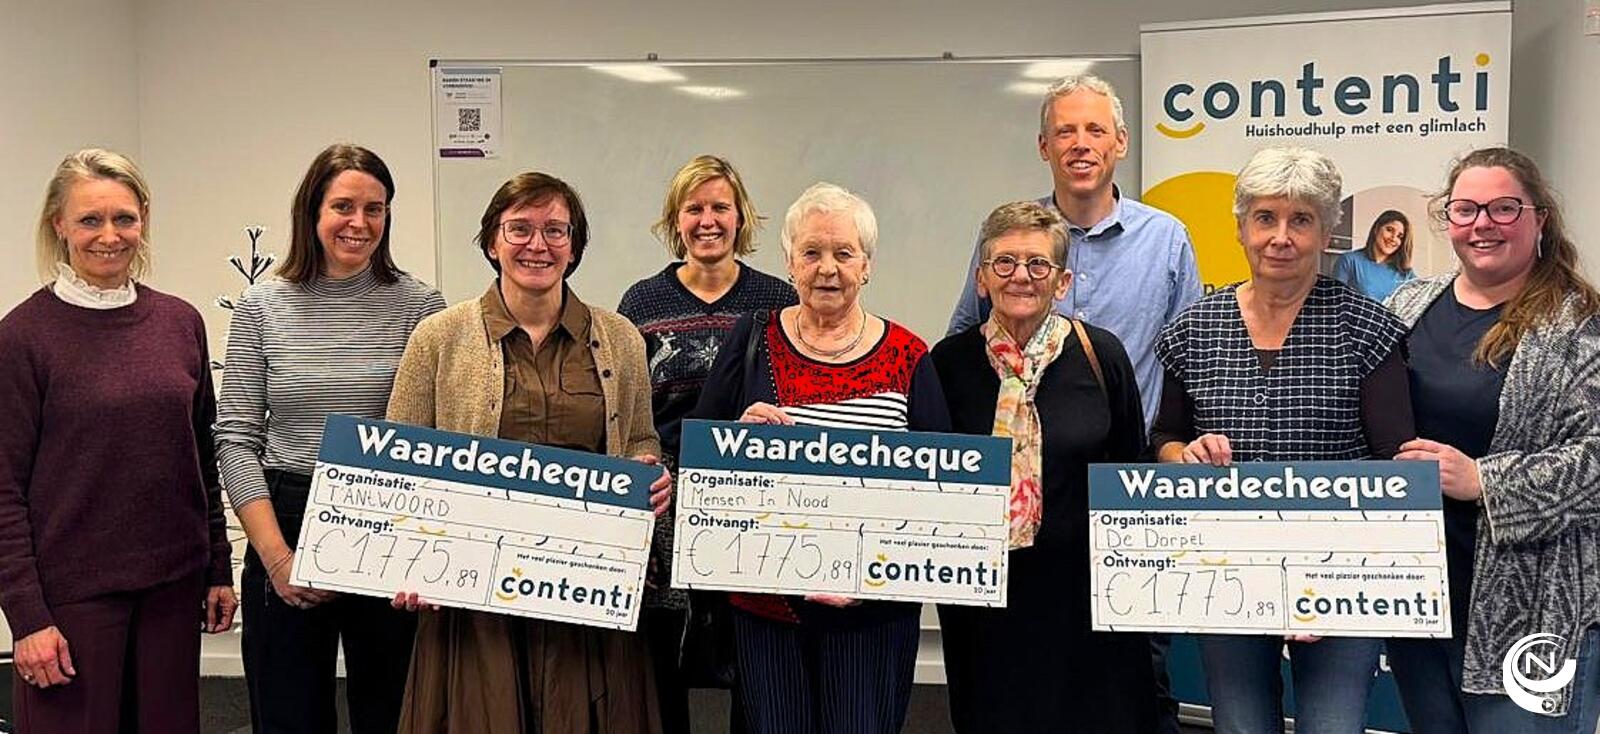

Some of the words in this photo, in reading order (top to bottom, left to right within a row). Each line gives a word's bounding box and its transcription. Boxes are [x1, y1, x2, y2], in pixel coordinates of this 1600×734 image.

[1163, 53, 1491, 122] contenti
[1246, 122, 1346, 139] Huishoudhulp
[1352, 122, 1381, 135] met
[1386, 123, 1413, 134] een
[1420, 118, 1486, 137] glimlach
[357, 424, 632, 498] Waardecheque
[711, 427, 982, 479] Waardecheque
[326, 468, 416, 491] Organisatie:
[690, 472, 774, 489] Organisatie:
[1118, 467, 1408, 508] Waardecheque
[691, 487, 746, 506] Mensen
[758, 489, 775, 507] In
[787, 488, 830, 508] Nood
[319, 511, 394, 533] Ontvangt:
[688, 514, 760, 532] Ontvangt:
[1101, 514, 1187, 530] Organisatie:
[1106, 528, 1132, 548] De
[868, 558, 997, 587] contenti
[1103, 556, 1176, 571] Ontvangt:
[501, 576, 632, 610] contenti
[1296, 590, 1439, 616] contenti
